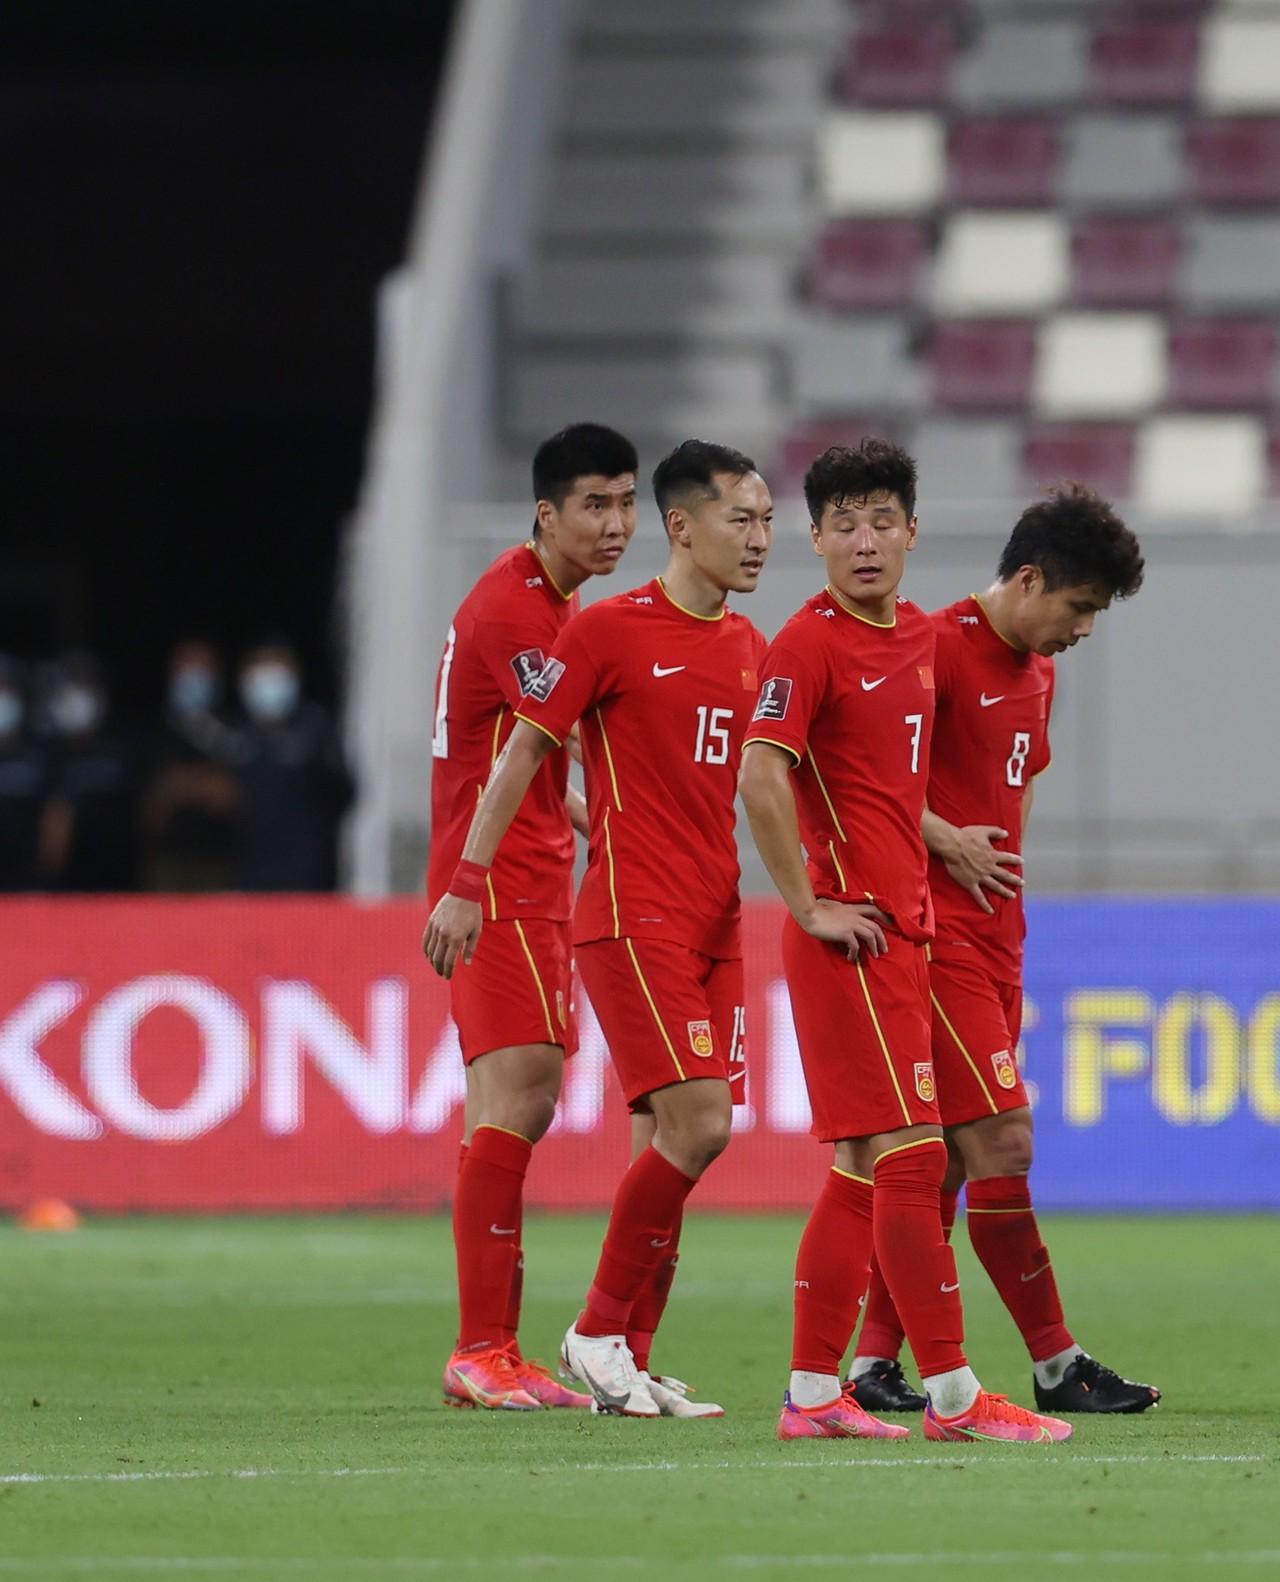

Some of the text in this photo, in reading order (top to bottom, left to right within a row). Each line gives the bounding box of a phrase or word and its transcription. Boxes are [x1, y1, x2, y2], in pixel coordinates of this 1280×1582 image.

[694, 705, 735, 766] 15
[904, 713, 923, 774] 7
[1006, 731, 1031, 787] 8
[0, 971, 815, 1141] KONI
